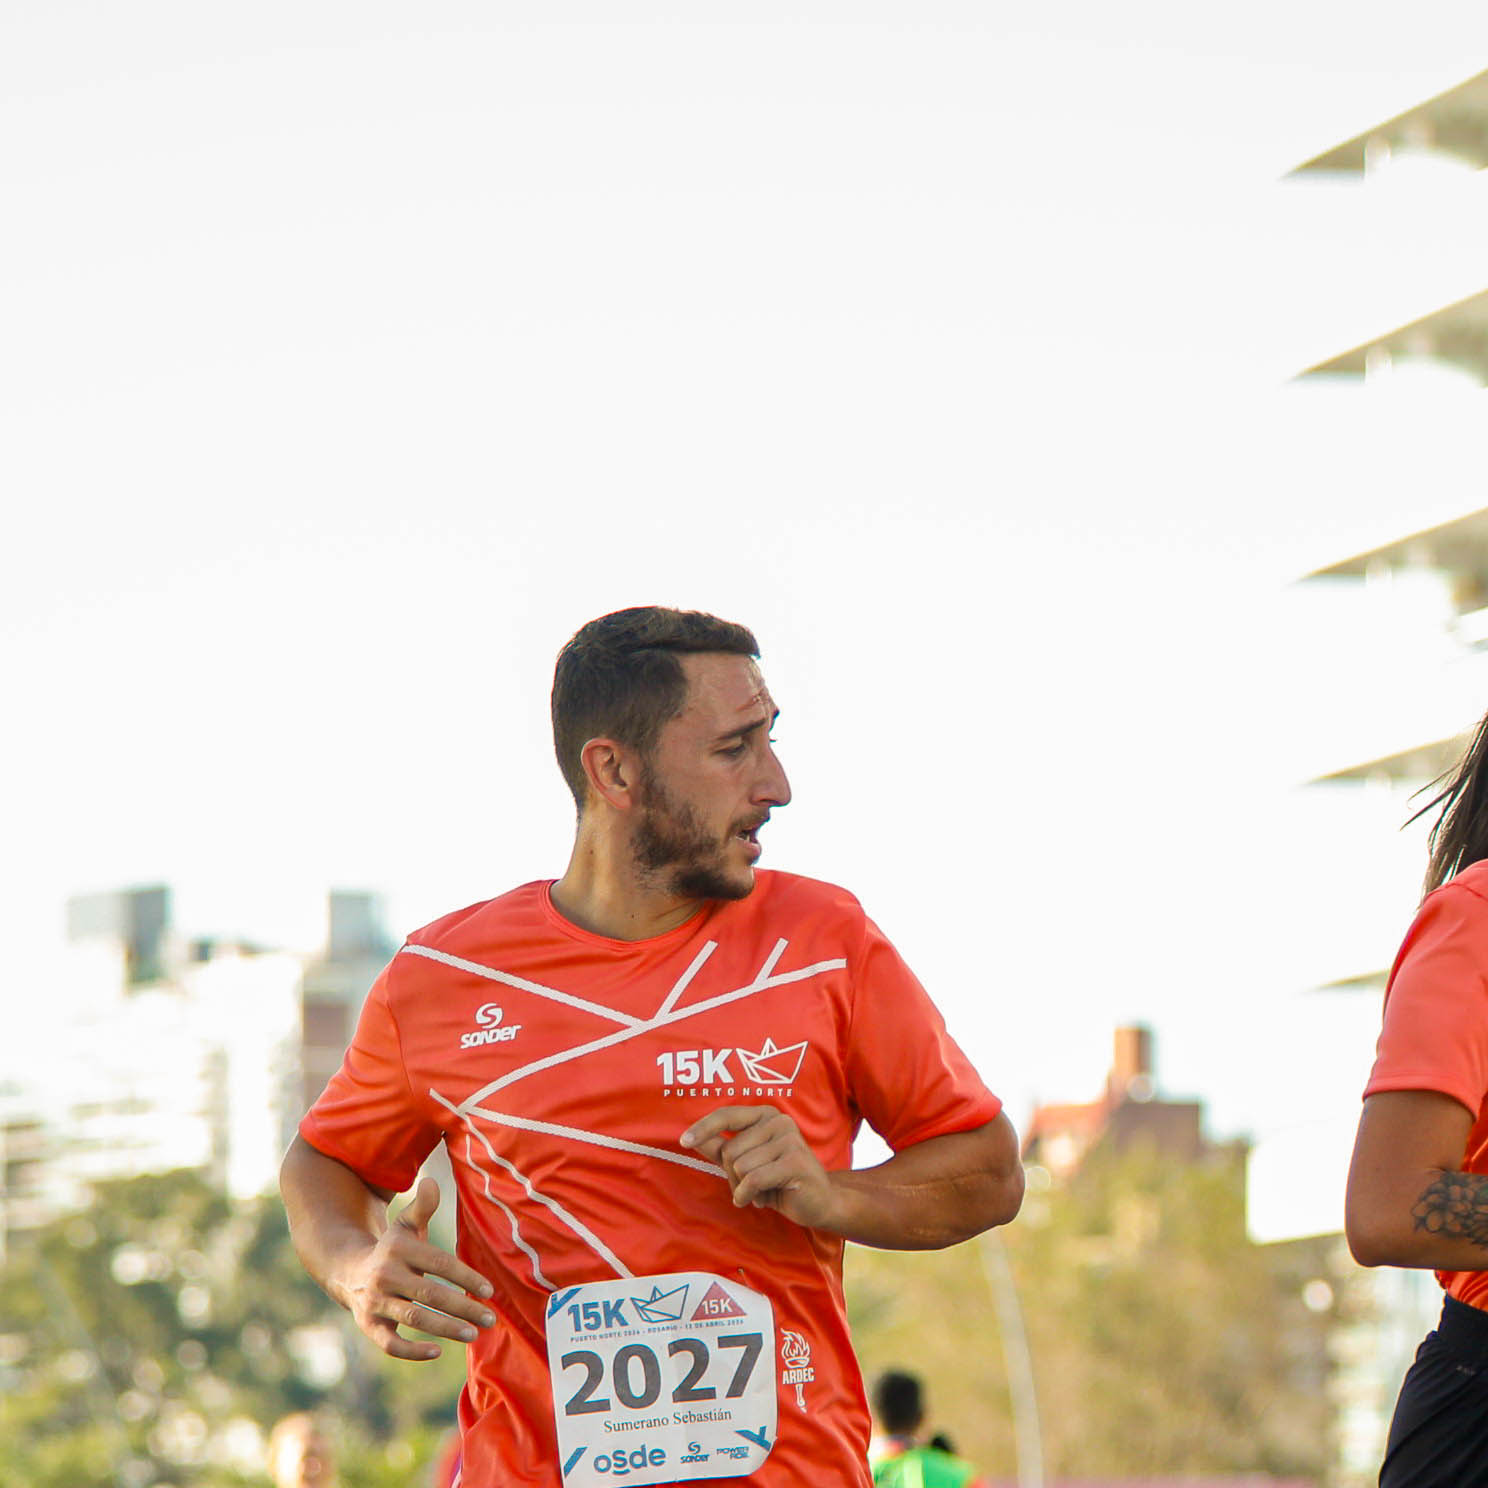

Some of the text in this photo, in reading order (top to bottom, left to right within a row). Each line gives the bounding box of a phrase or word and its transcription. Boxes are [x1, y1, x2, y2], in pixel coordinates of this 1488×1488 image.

[656, 1049, 735, 1085] 15K
[664, 1088, 793, 1097] PUERTO NORTE
[568, 1298, 629, 1333] 15K
[701, 1297, 734, 1315] 15K
[560, 1332, 765, 1417] 2027
[782, 1367, 815, 1385] ARDEC
[603, 1408, 733, 1434] Sumerano Sebastián
[593, 1444, 666, 1475] osde
